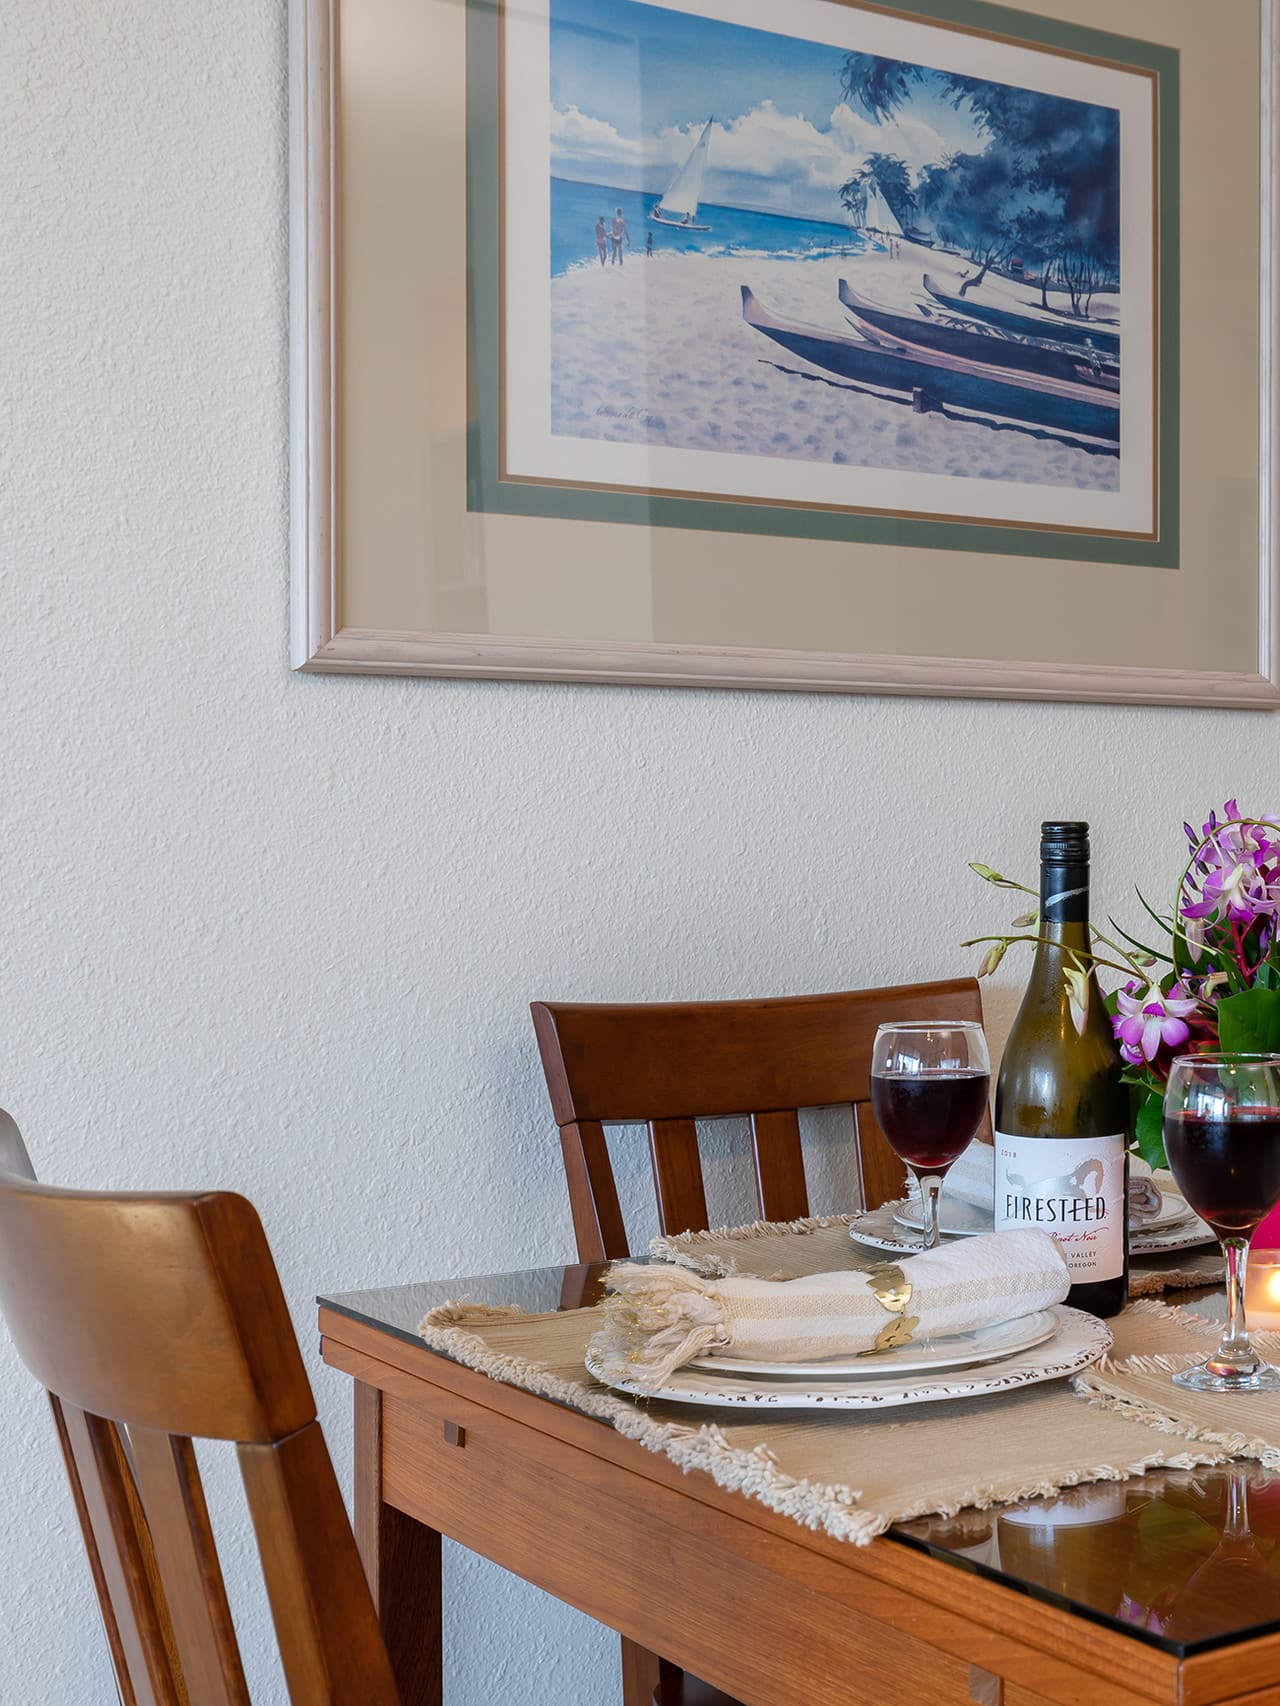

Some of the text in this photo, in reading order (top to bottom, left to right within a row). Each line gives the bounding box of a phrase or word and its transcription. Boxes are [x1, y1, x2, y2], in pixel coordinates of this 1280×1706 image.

[1006, 1194, 1106, 1222] FIRESTEED
[1075, 1228, 1105, 1243] Noir
[1071, 1251, 1097, 1259] VALLEY
[1068, 1261, 1097, 1269] OREGON
